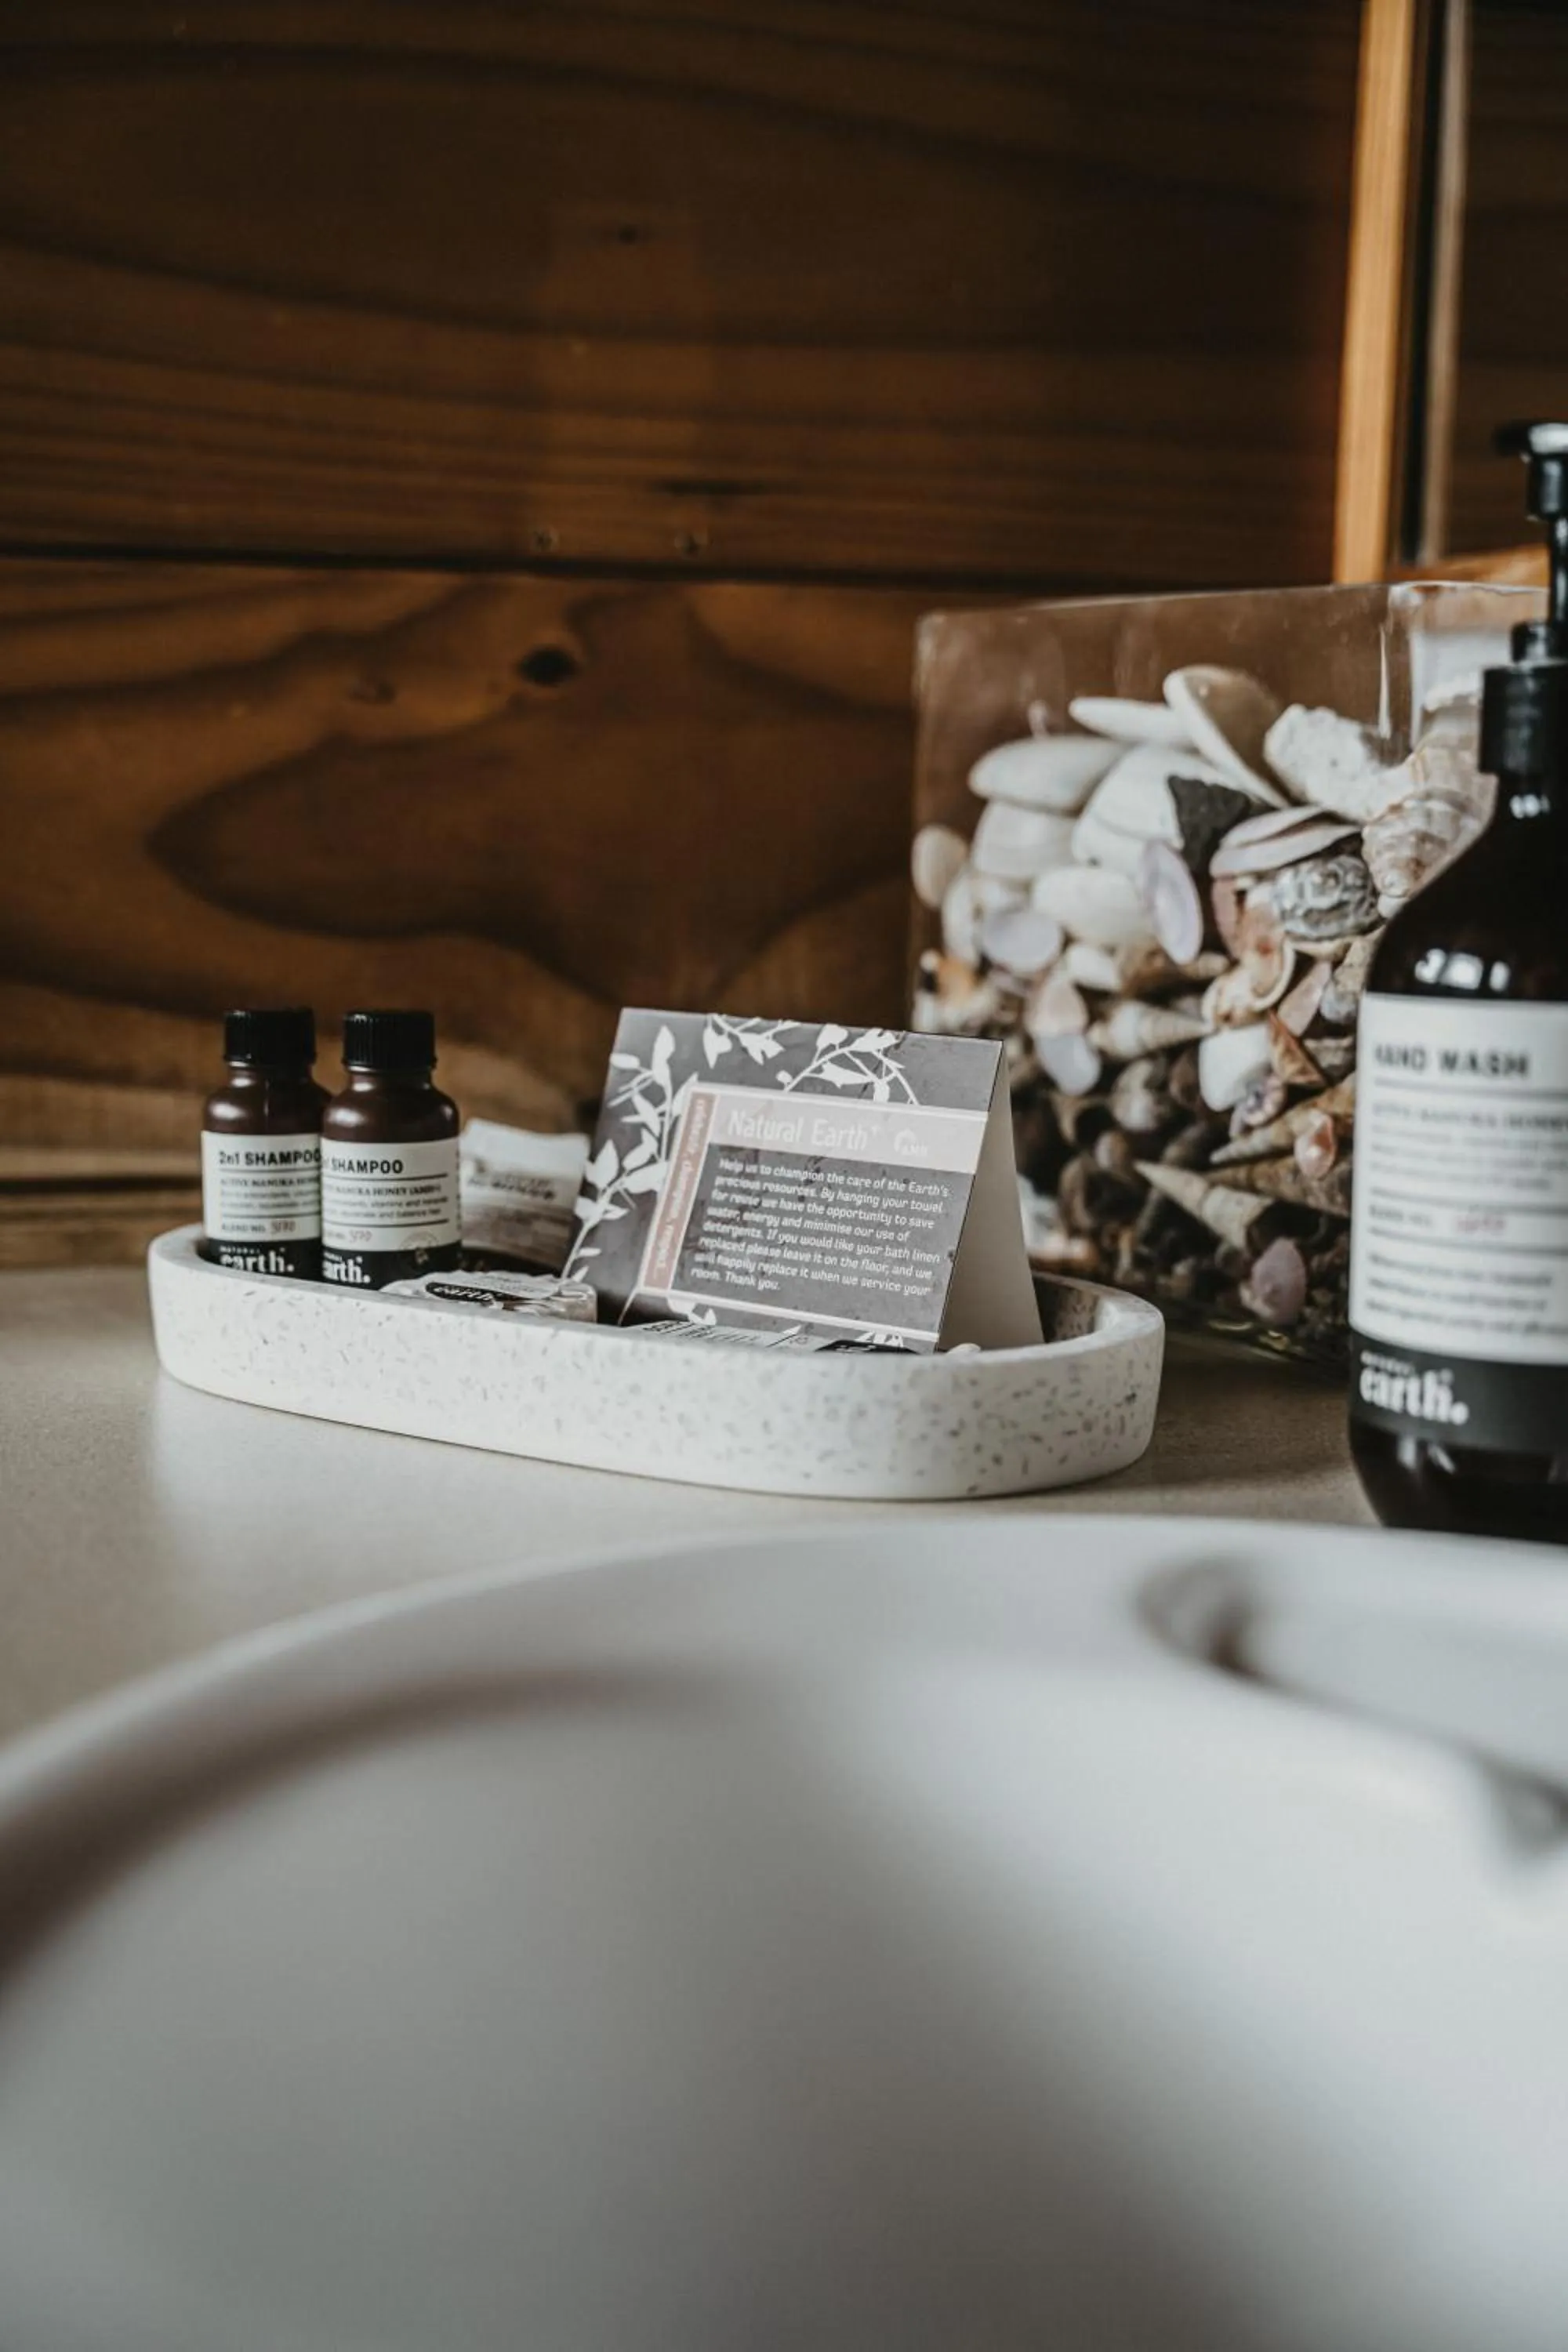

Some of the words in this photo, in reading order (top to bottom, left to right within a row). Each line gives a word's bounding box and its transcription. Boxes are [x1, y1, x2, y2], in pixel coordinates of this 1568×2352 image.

[1438, 1048, 1531, 1079] WASH
[728, 1109, 804, 1143] Natural
[220, 1150, 241, 1165] 2n1
[332, 1159, 404, 1174] SHAMPOO
[715, 1176, 761, 1191] precious
[821, 1187, 836, 1201] By
[837, 1189, 880, 1208] hanging
[882, 1197, 909, 1209] your
[910, 1200, 944, 1214] towel
[720, 1158, 744, 1173] Help
[745, 1163, 758, 1173] us
[760, 1164, 771, 1174] to
[774, 1167, 824, 1183] champion
[826, 1172, 844, 1185] the
[847, 1177, 872, 1189] care
[873, 1177, 887, 1189] of
[887, 1179, 906, 1192] the
[909, 1181, 949, 1197] Earth's
[706, 1207, 741, 1221] water,
[742, 1211, 781, 1227] energy
[782, 1216, 803, 1228] and
[804, 1218, 852, 1235] minimise
[854, 1226, 874, 1237] our
[876, 1230, 895, 1240] use
[896, 1229, 912, 1242] of
[711, 1189, 729, 1200] for
[761, 1198, 779, 1208] we
[779, 1198, 805, 1212] have
[807, 1203, 826, 1214] the
[826, 1207, 894, 1227] opportunity
[895, 1214, 907, 1225] to
[909, 1218, 935, 1229] save
[698, 1236, 746, 1253] replaced
[746, 1245, 782, 1258] please
[782, 1247, 811, 1262] leave
[812, 1250, 822, 1263] it
[824, 1255, 838, 1265] on
[840, 1257, 859, 1269] the
[891, 1265, 913, 1279] and
[915, 1269, 933, 1279] we
[766, 1228, 779, 1240] If
[779, 1233, 798, 1245] you
[799, 1234, 833, 1249] would
[834, 1238, 855, 1251] like
[856, 1243, 884, 1255] your
[885, 1245, 911, 1260] bath
[912, 1248, 942, 1264] linen
[322, 1256, 372, 1284] arth.
[694, 1252, 717, 1265] will
[717, 1254, 757, 1273] happily
[757, 1261, 799, 1277] replace
[799, 1267, 809, 1279] it
[811, 1269, 840, 1283] when
[841, 1275, 858, 1286] we
[861, 1277, 902, 1292] service
[903, 1284, 931, 1296] your
[724, 1270, 757, 1287] Thank
[757, 1279, 781, 1291] you.
[1360, 1367, 1469, 1427] earth.
